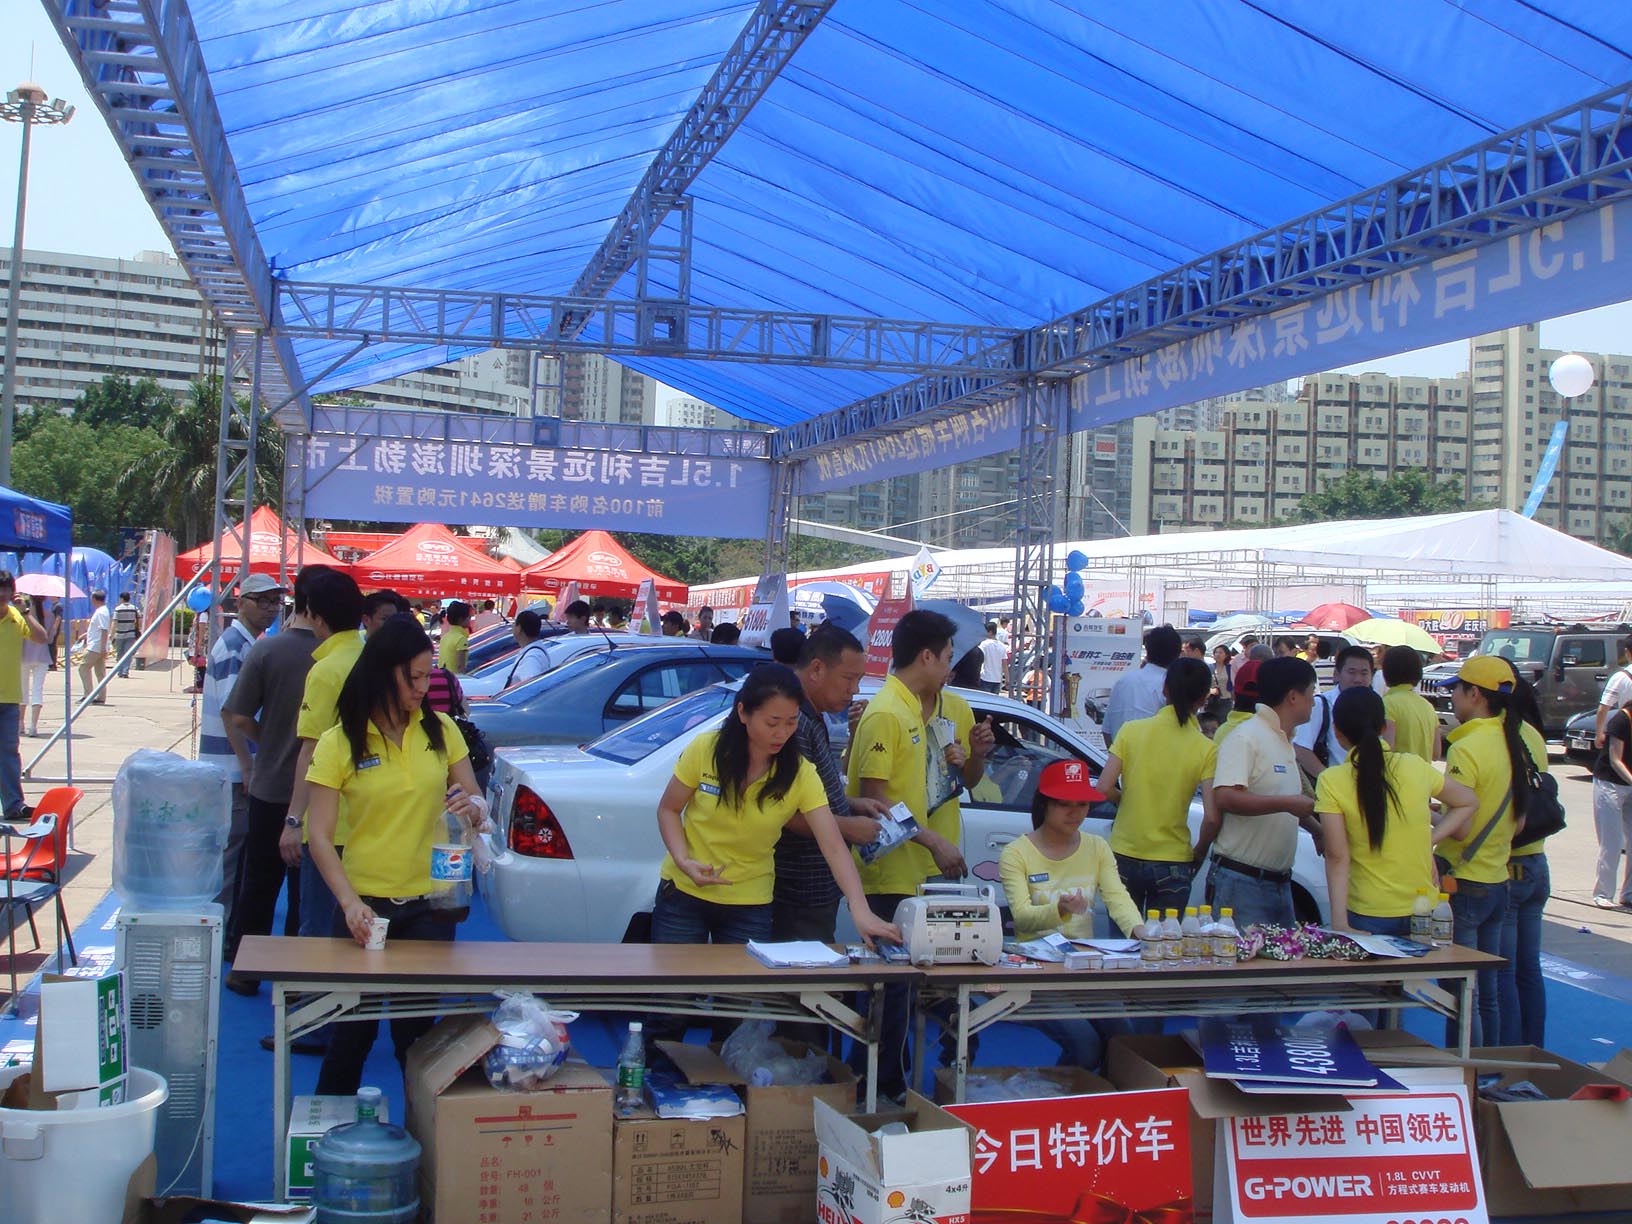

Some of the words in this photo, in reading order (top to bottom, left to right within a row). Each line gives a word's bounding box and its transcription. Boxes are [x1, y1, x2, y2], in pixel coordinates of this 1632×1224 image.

[1240, 1114, 1346, 1147] 世界先进
[1356, 1111, 1458, 1146] 中国领先
[974, 1115, 1175, 1175] 今日特价车
[1244, 1174, 1374, 1200] G-POWER
[1386, 1171, 1407, 1182] 1.8L
[1411, 1170, 1441, 1181] CVVT
[1387, 1183, 1471, 1196] 方程式赛车发动机
